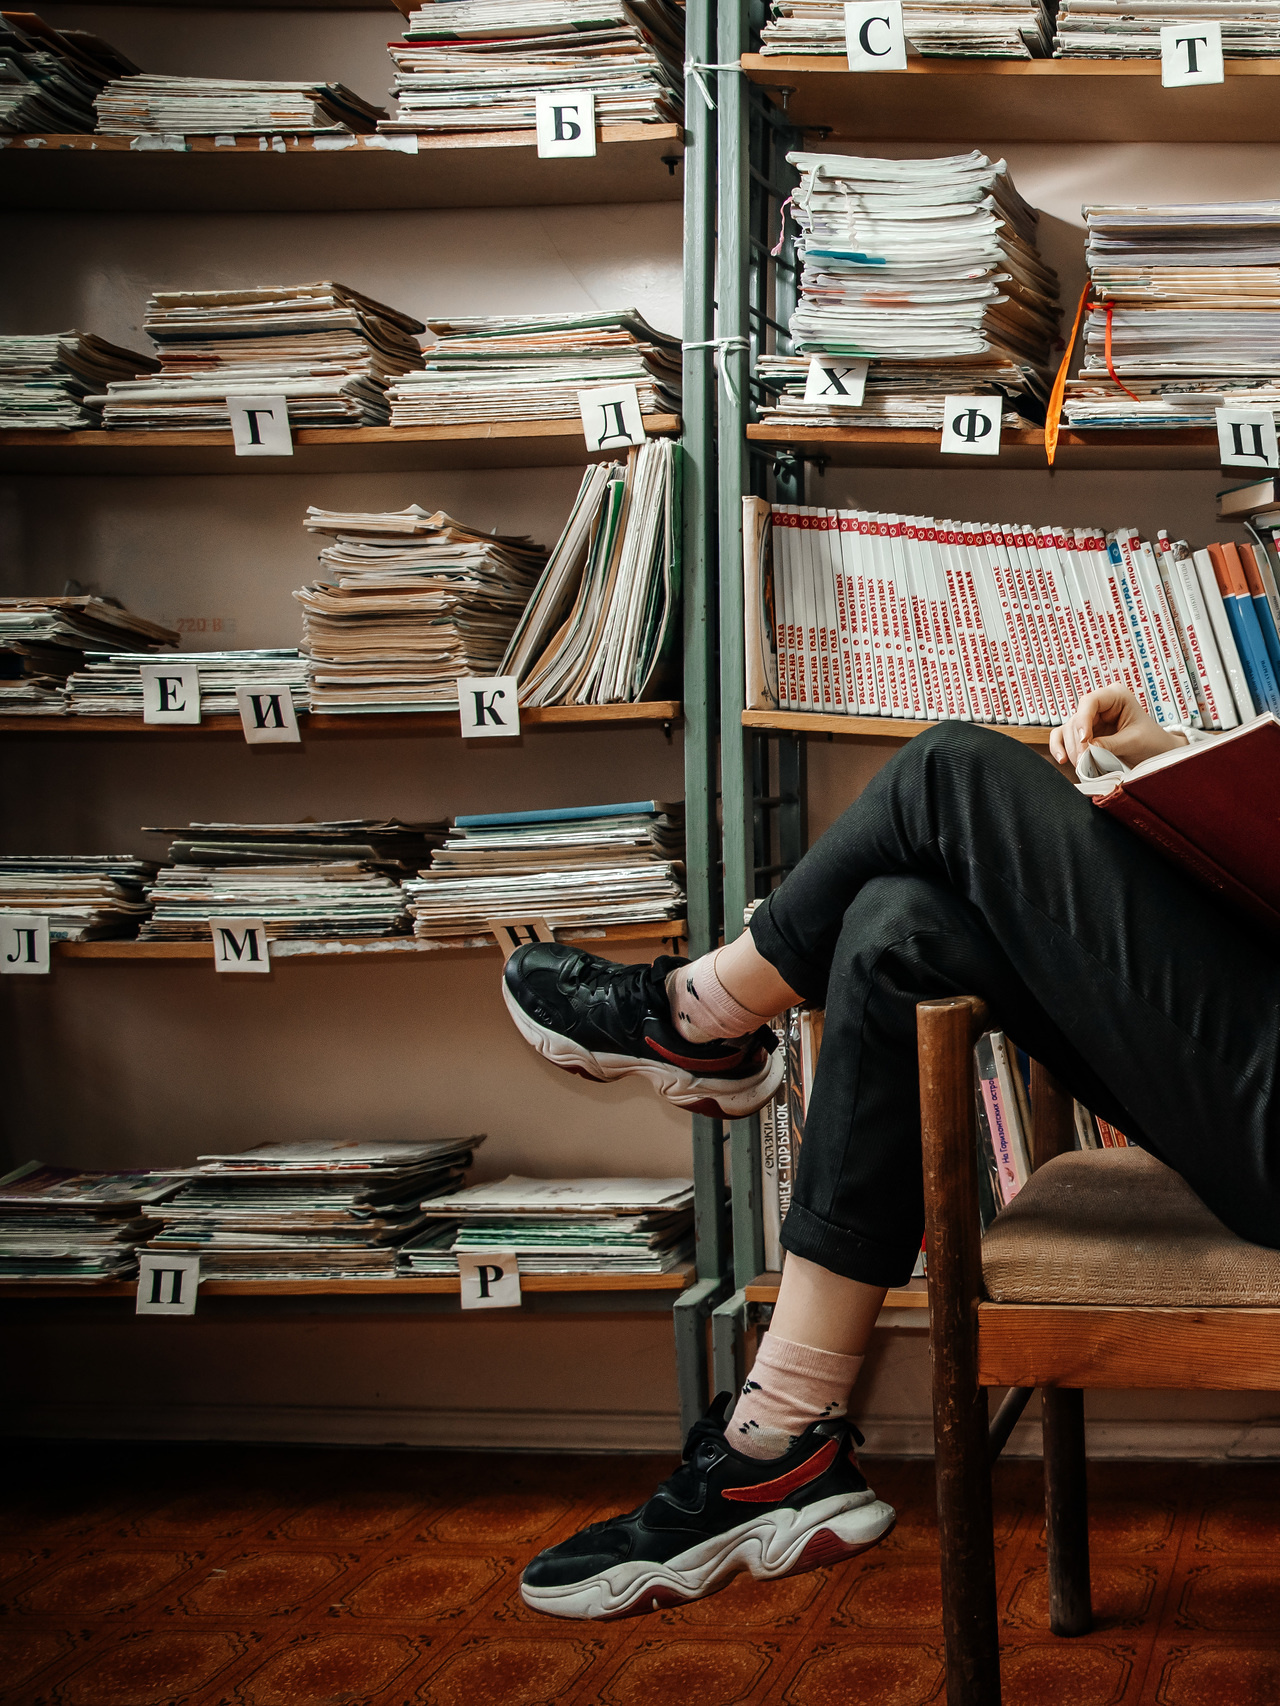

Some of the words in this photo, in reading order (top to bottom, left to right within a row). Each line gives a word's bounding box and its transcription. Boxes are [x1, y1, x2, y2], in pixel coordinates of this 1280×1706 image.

[859, 16, 891, 56] С
[1175, 37, 1207, 73] Т
[551, 106, 581, 141] Б
[819, 367, 856, 395] Х
[242, 409, 273, 444] Г
[597, 400, 633, 447] Д
[953, 409, 991, 442] Ф
[1229, 424, 1269, 462] Ц
[993, 566, 1006, 598] ШКОЛЕ
[1121, 543, 1142, 597] ЛЕОПОЛЬДА
[836, 574, 847, 631] ЖИВОТНЫХ
[946, 570, 962, 628] ПРАЗДНИКИ
[1135, 598, 1148, 622] КОТА
[900, 597, 911, 641] ПРИРОДЕ
[1064, 606, 1080, 649] ПРИРОДЕ
[1084, 600, 1097, 635] ШКОЛЕ
[1131, 614, 1139, 626] ПО
[990, 641, 1000, 662] ЛЕСА
[1005, 612, 1022, 663] РАССКАЗЫ
[1135, 631, 1146, 659] ГОСТИ
[1144, 626, 1162, 676] РОЖДЕНИЯ
[1187, 624, 1207, 678] КРЫЛОВА
[958, 632, 974, 682] ЛЮБИМЫЕ
[996, 665, 1004, 677] ИЗ
[1096, 642, 1108, 671] СТИХИ
[1144, 660, 1149, 668] В
[843, 651, 854, 702] РАССКАЗЫ
[908, 659, 921, 711] РАССКАЗЫ
[1019, 667, 1035, 714] СМЕШНЫЕ
[1146, 672, 1159, 704] ХОДИТ
[1159, 678, 1171, 703] ДЕНЬ
[1169, 667, 1188, 720] ШКОЛЬНЫЕ
[156, 677, 185, 712] Е
[253, 694, 288, 728] И
[472, 690, 506, 726] К
[969, 686, 980, 714] НАШИ
[999, 681, 1012, 717] СКАЗКИ
[1203, 684, 1219, 720] БАСНИ
[1154, 705, 1164, 723] КТО
[7, 928, 37, 963] Л
[218, 928, 260, 962] М
[776, 1103, 791, 1169] ГОРБУНОК
[992, 1104, 1007, 1152] Горизонтских
[1001, 1153, 1009, 1163] На
[149, 1268, 184, 1304] П
[475, 1264, 503, 1298] Р
